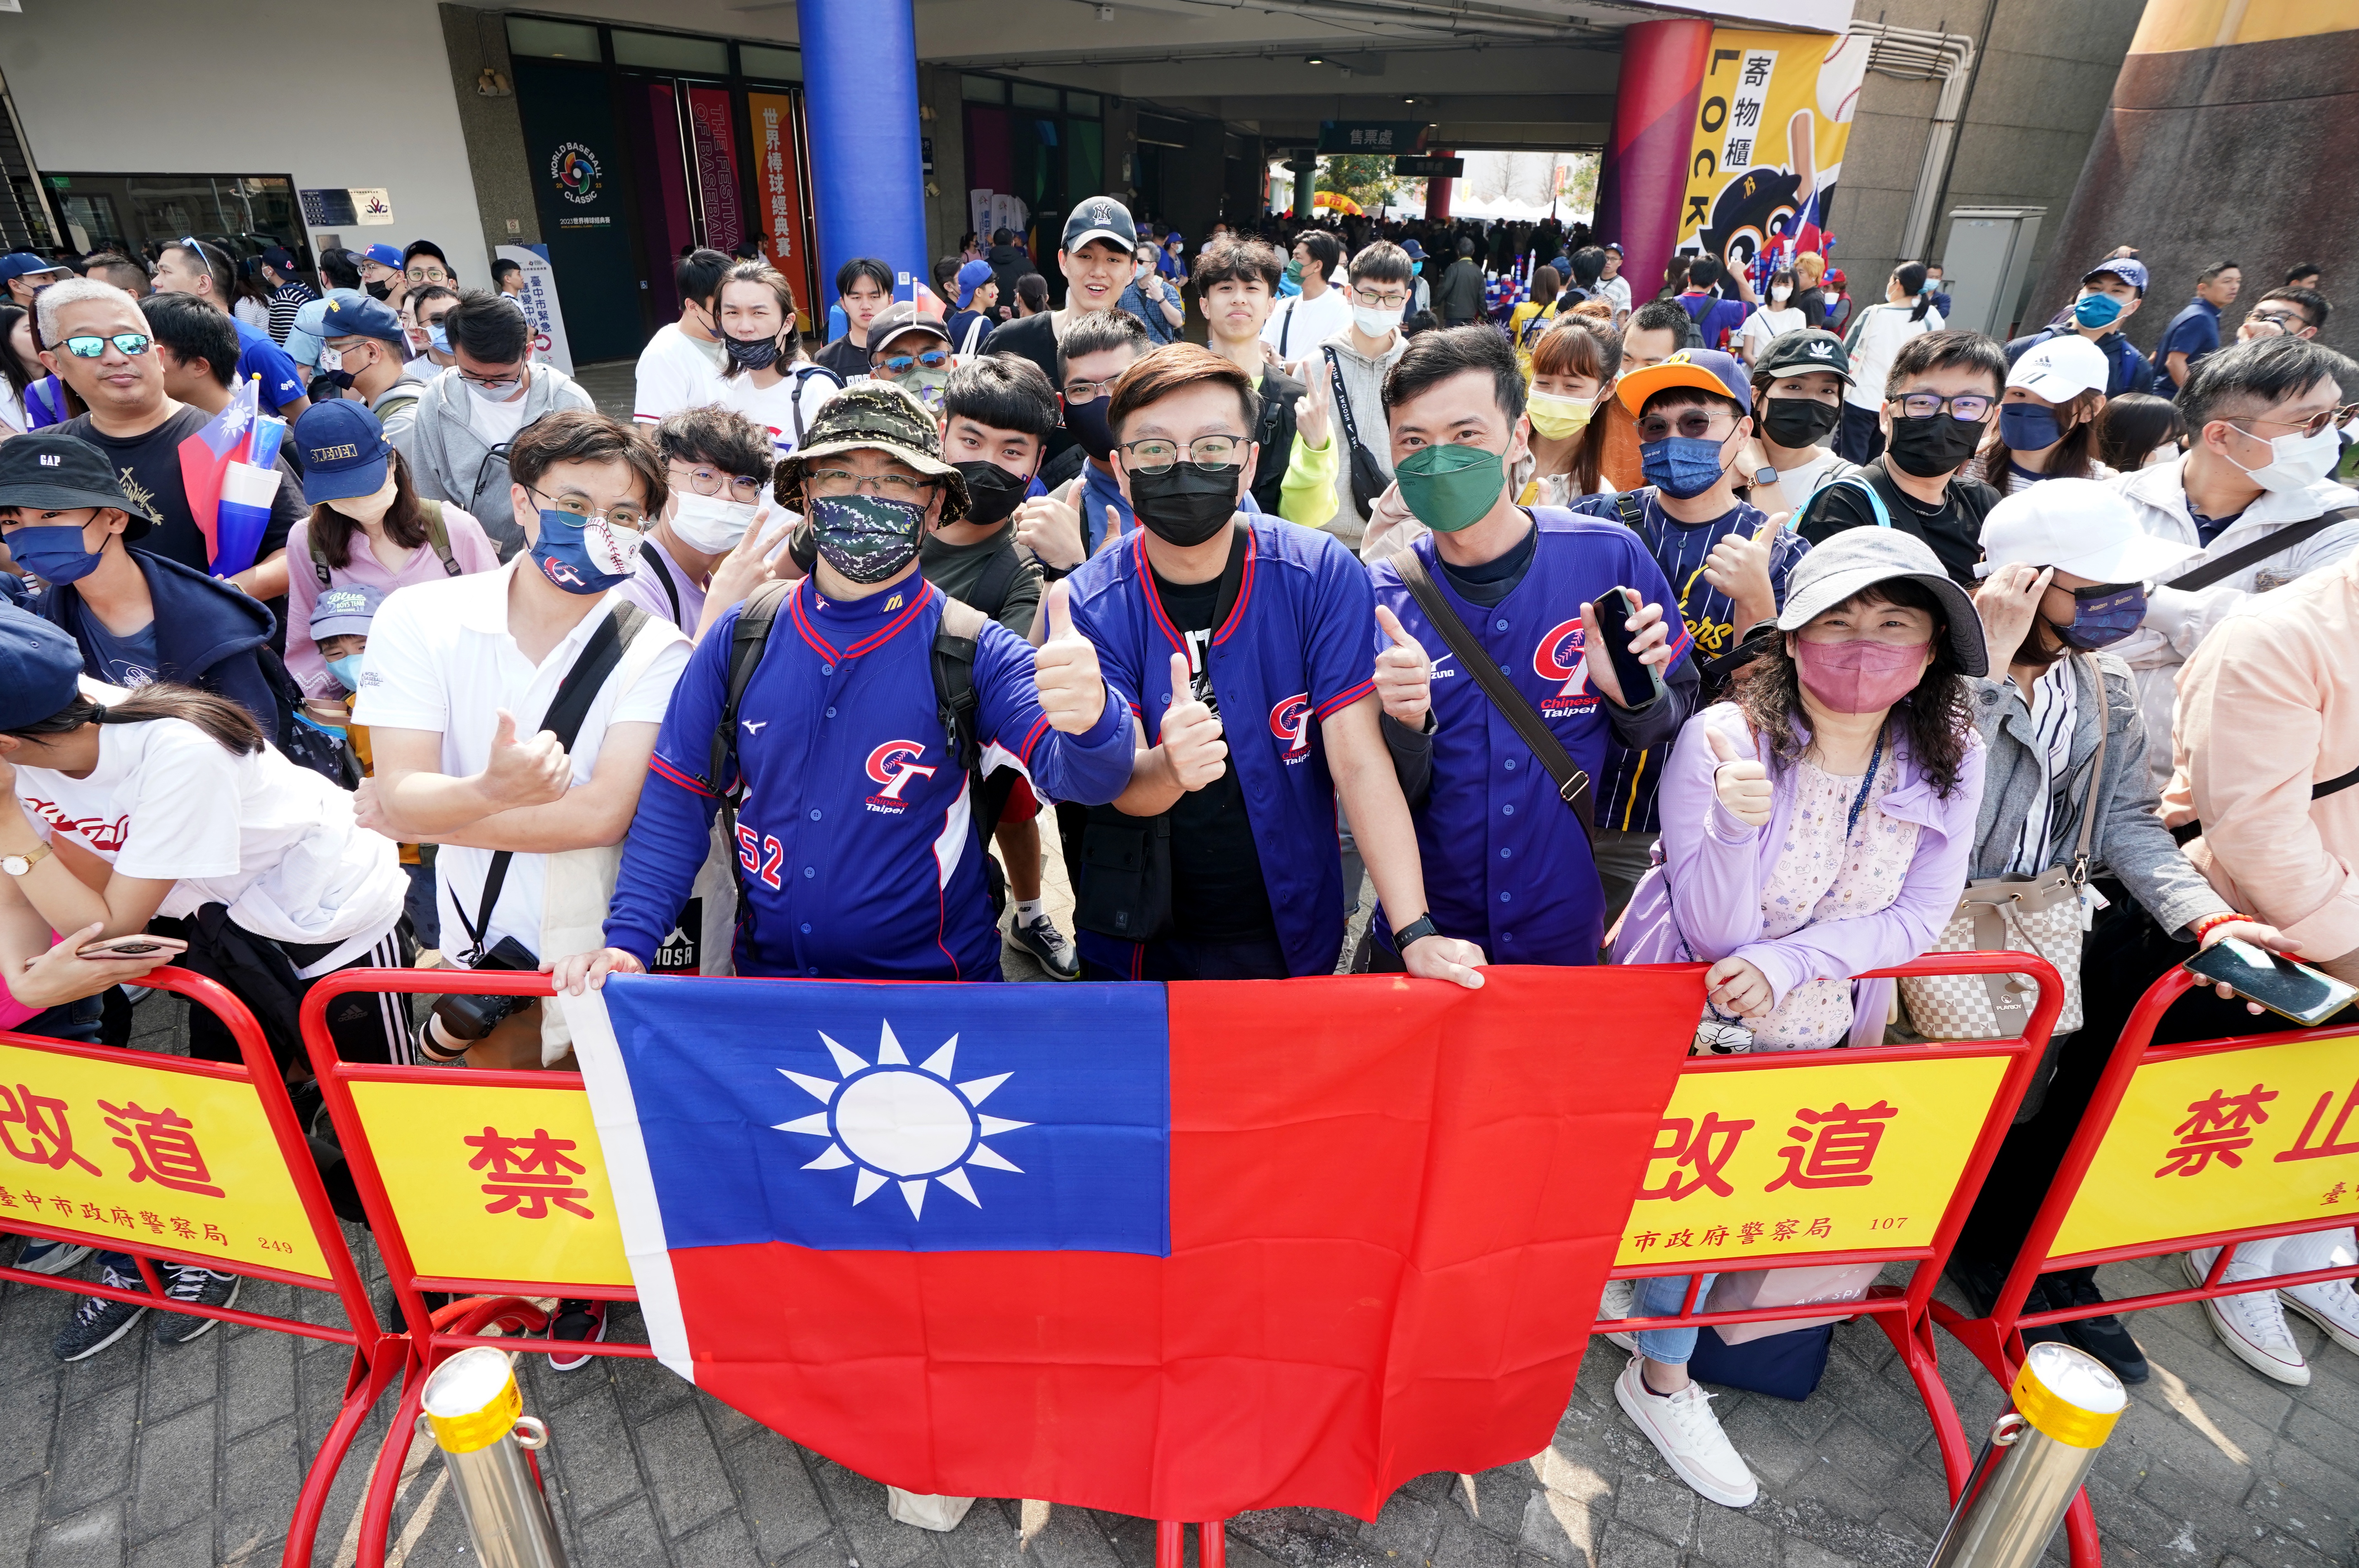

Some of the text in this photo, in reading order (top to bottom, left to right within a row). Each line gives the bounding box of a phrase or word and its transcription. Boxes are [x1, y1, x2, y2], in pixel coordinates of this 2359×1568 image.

[694, 103, 711, 136] OF
[1725, 56, 1772, 166] 寄物櫃
[710, 104, 728, 151] THE
[1350, 129, 1393, 145] 售票處
[551, 142, 602, 179] WORLD BASEBALL
[762, 107, 791, 258] 世界棒球經典賽
[564, 190, 597, 204] CLASSIC
[530, 275, 552, 333] 臺中市緊急
[1327, 354, 1339, 380] SWOSH
[1339, 394, 1351, 422] SWOOSH
[40, 454, 61, 467] GAP
[310, 444, 358, 463] SWEDEN
[327, 591, 366, 604] Blue
[1540, 695, 1601, 709] Chinese
[1542, 704, 1597, 719] Taipei
[865, 796, 909, 808] Chinese
[866, 803, 905, 814] Taipei
[736, 821, 785, 890] 52
[337, 1011, 369, 1022] adidas
[0, 1083, 226, 1198] 改道
[2154, 1083, 2359, 1179] 禁止
[1634, 1099, 1899, 1202] 改道
[463, 1126, 595, 1220] 禁
[2320, 1181, 2359, 1206] 臺
[0, 1186, 228, 1246] 臺中市政府警察局
[1868, 1217, 1909, 1230] 107
[258, 1237, 293, 1254] 249
[1633, 1217, 1832, 1253] 市政府警察局
